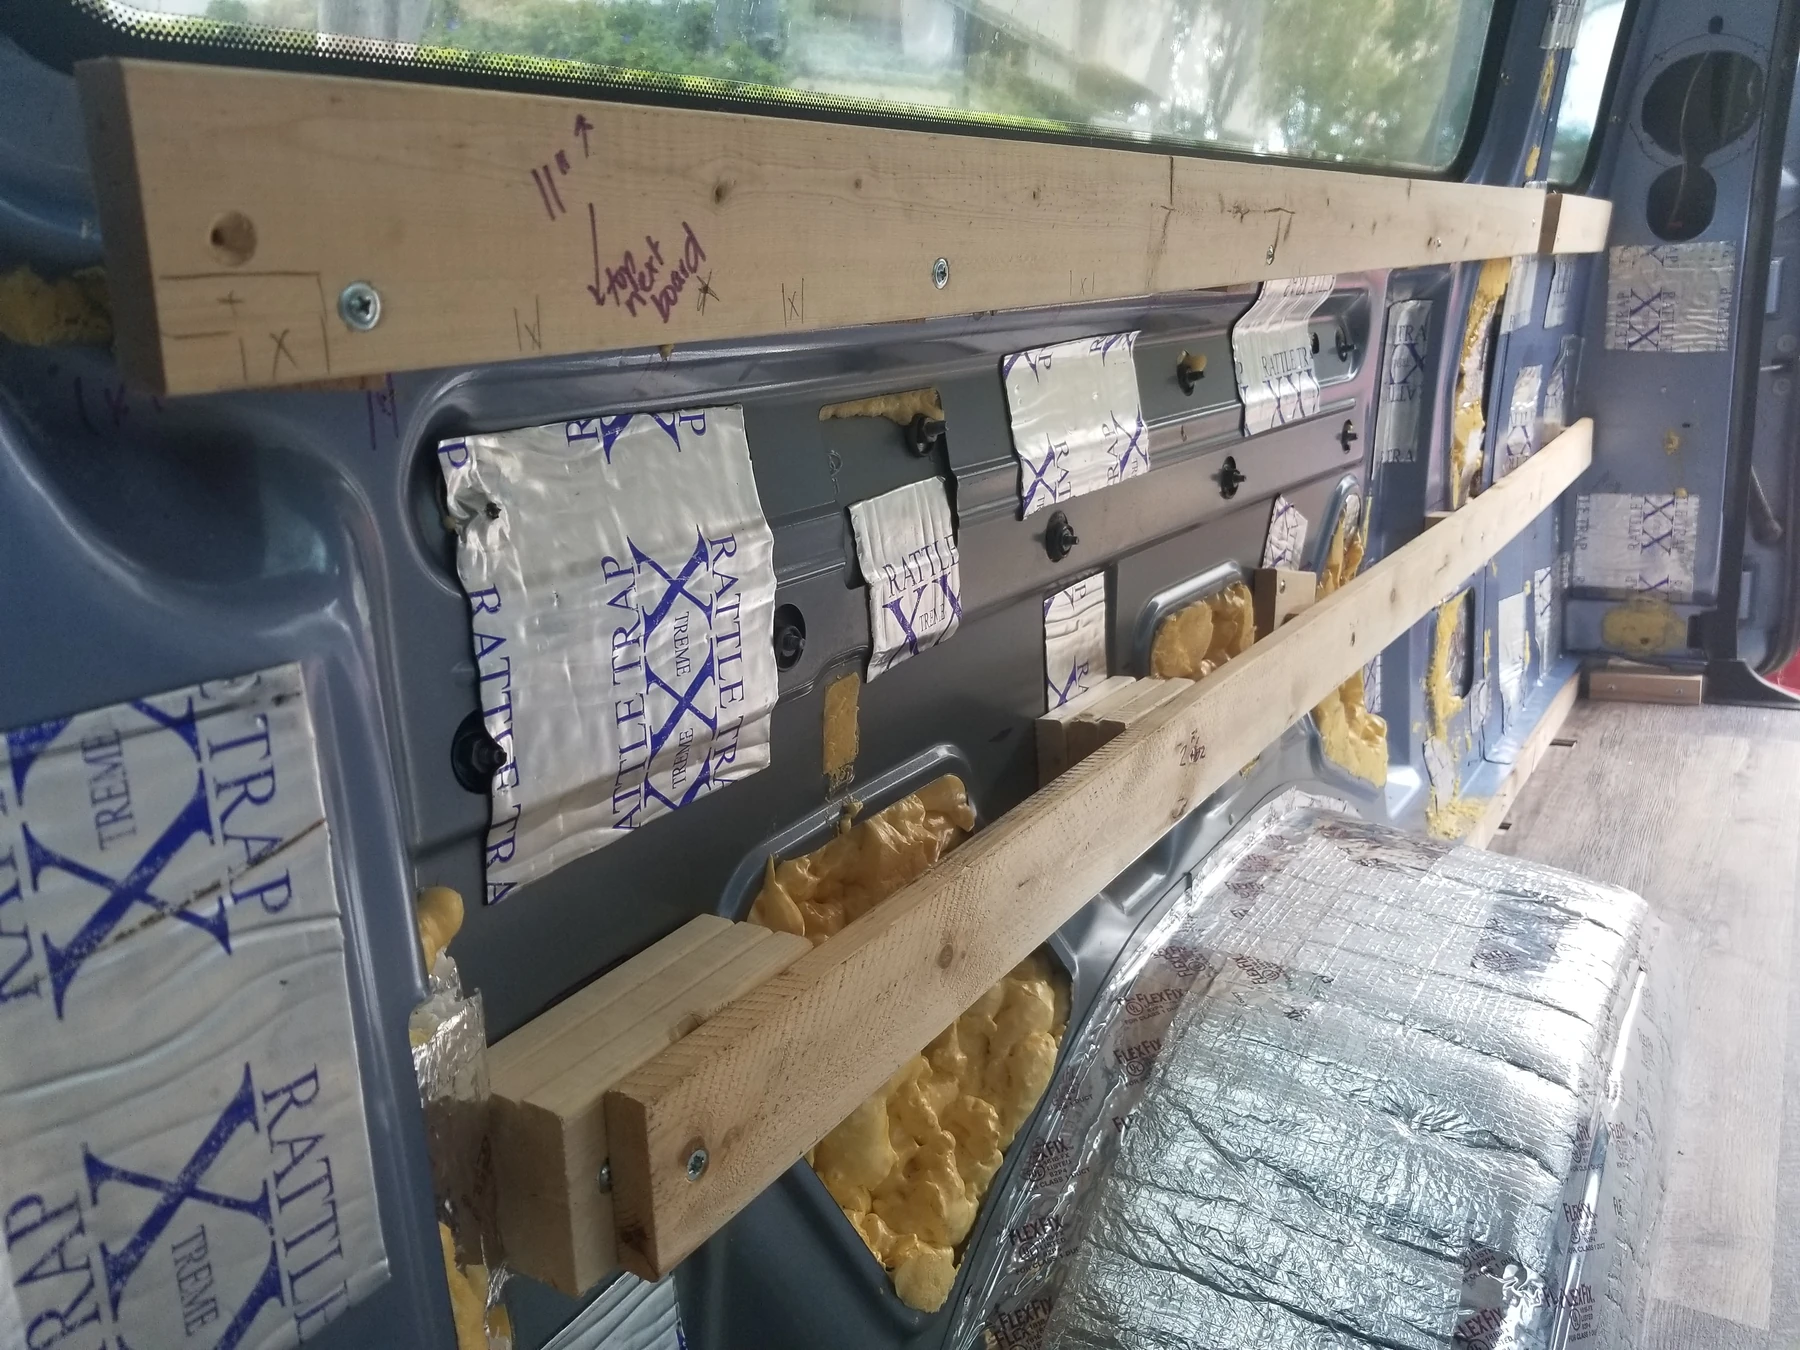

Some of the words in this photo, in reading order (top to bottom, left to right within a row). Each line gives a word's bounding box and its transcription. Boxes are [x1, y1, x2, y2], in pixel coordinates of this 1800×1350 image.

[624, 235, 665, 319] next
[650, 220, 707, 324] board
[1053, 440, 1072, 499] RAT
[1101, 422, 1119, 487] RAP
[882, 533, 960, 598] RATTLE
[601, 555, 643, 687] TRAP
[709, 532, 745, 711] RATTLE
[612, 692, 652, 832] ATTLE
[206, 711, 293, 917] TRAP
[485, 803, 523, 906] TRA
[3, 1190, 106, 1350] RAP
[1457, 1306, 1508, 1339] LEXFIX
